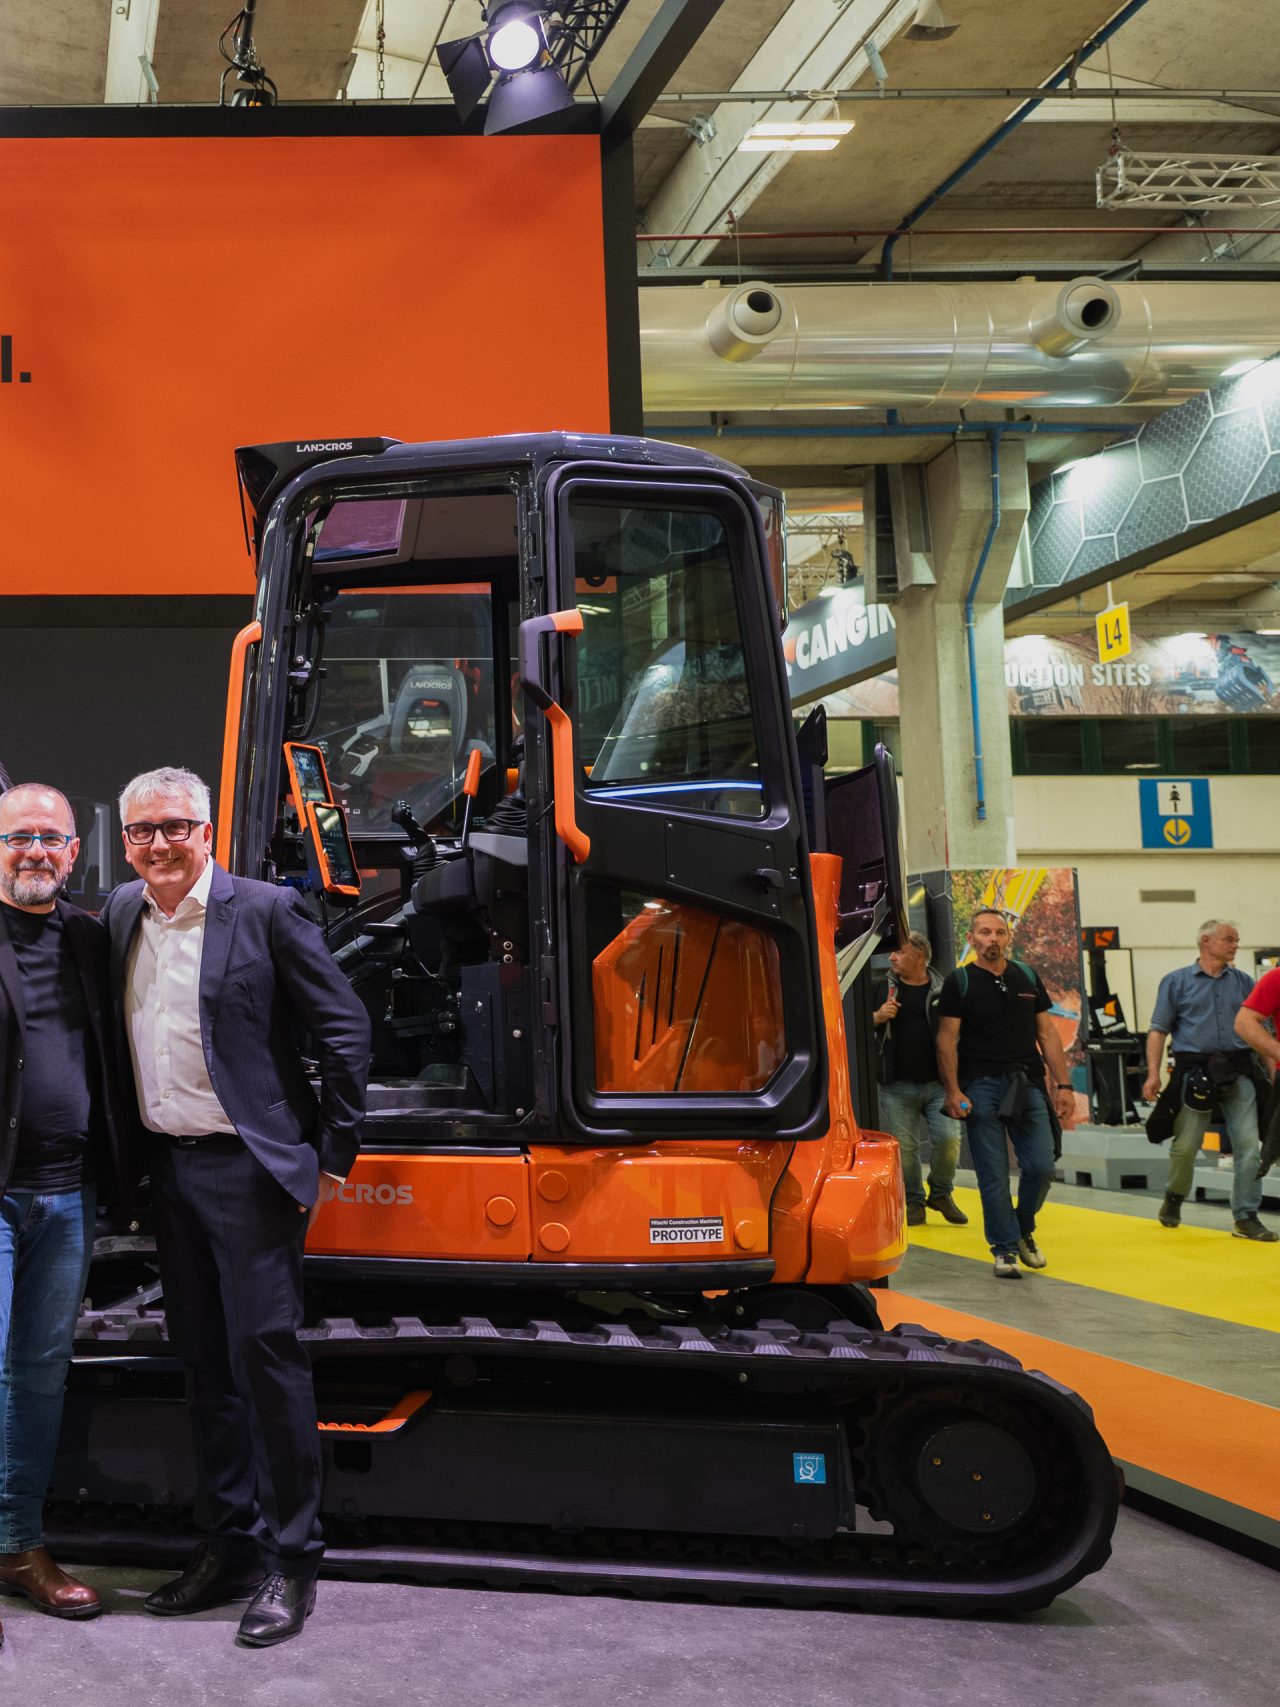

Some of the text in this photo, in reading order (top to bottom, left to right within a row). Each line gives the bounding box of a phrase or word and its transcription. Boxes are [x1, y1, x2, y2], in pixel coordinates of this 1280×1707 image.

[296, 442, 353, 453] LANDCROS
[1105, 618, 1122, 650] L4
[1091, 663, 1152, 687] SITES
[652, 1228, 722, 1241] PROTOTYPE
